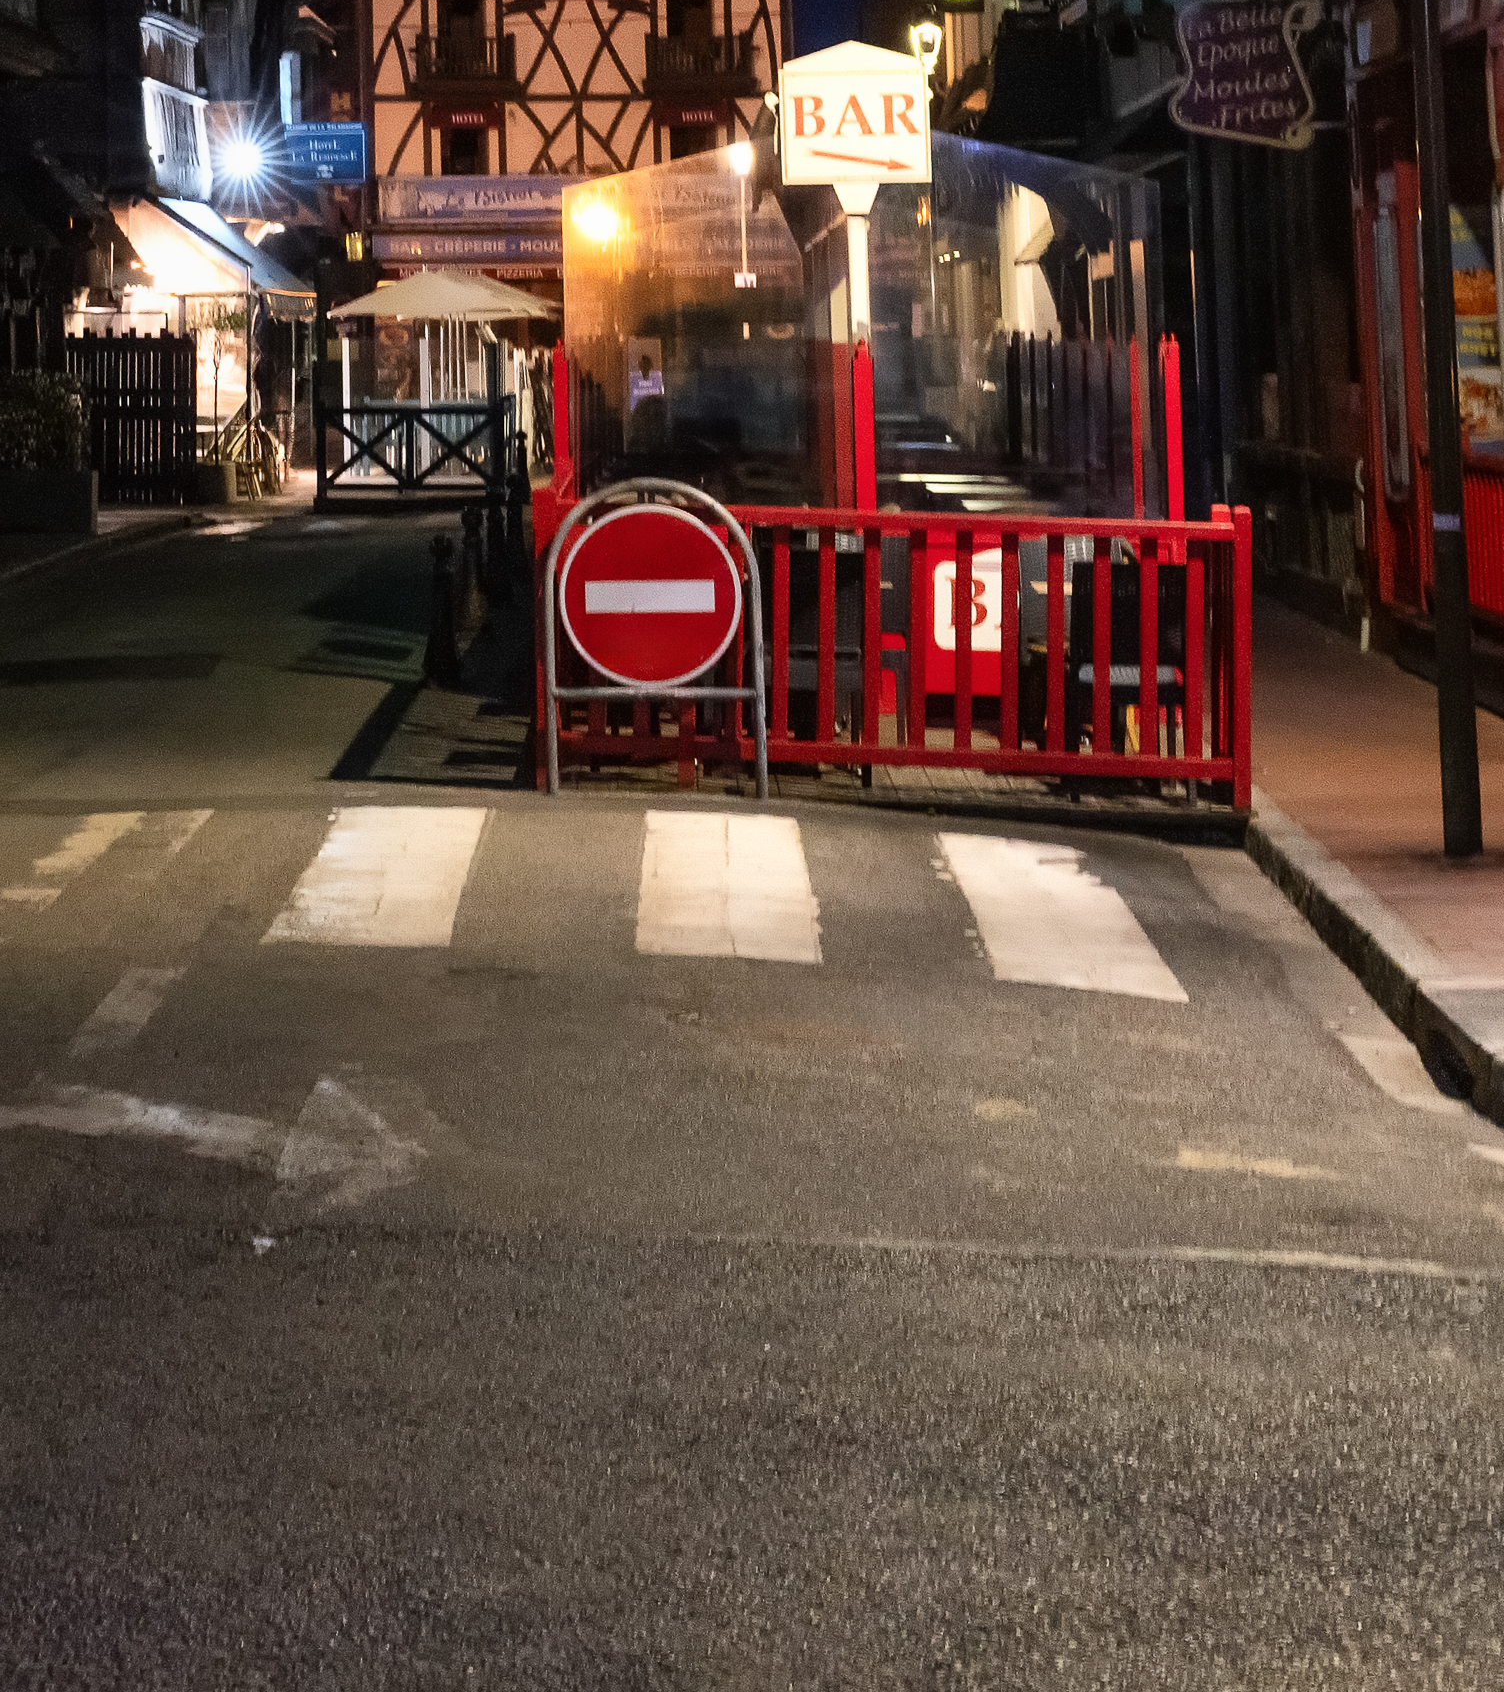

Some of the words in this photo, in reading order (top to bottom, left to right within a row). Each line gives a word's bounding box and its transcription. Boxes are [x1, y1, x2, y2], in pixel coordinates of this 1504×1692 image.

[1217, 2, 1282, 35] Belle
[1193, 68, 1291, 105] Moules
[450, 112, 485, 124] HOTEL
[681, 111, 715, 122] HOTEL
[790, 92, 922, 139] BAR
[1219, 98, 1298, 130] Frites
[434, 237, 507, 254] CRÊPERIE
[519, 239, 562, 254] MOUL
